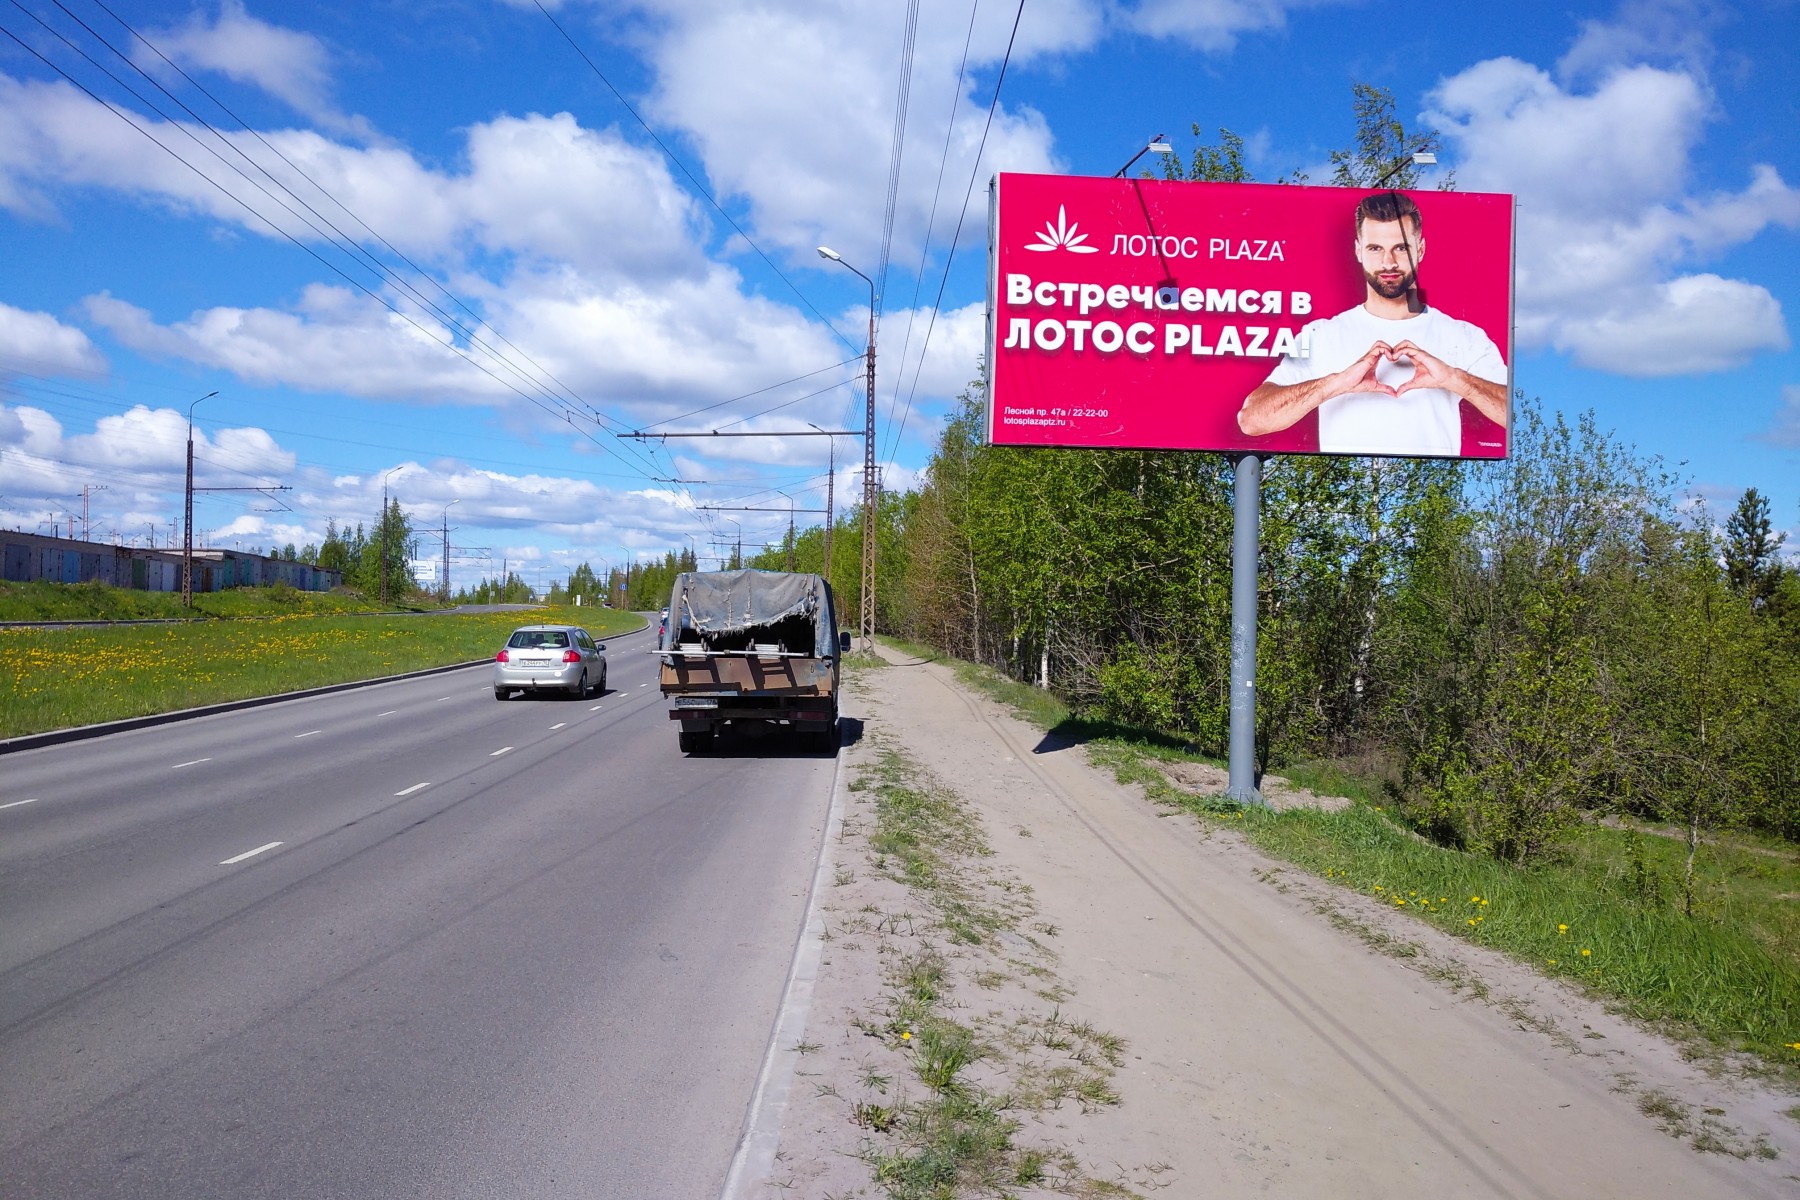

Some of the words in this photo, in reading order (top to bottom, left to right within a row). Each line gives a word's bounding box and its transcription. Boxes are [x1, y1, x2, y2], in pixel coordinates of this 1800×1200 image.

[1110, 234, 1198, 259] ЛОТОС
[1007, 273, 1282, 315] Встречаемся
[1291, 291, 1312, 315] в
[1004, 318, 1156, 354] ЛОТОС
[1165, 323, 1310, 359] PLAZA!
[1004, 406, 1034, 415] Лесной
[1036, 408, 1048, 416] пр.
[1051, 408, 1066, 416] 47а
[1073, 408, 1109, 417] 22-22-00
[1004, 416, 1066, 427] lotosplazaptz.ru
